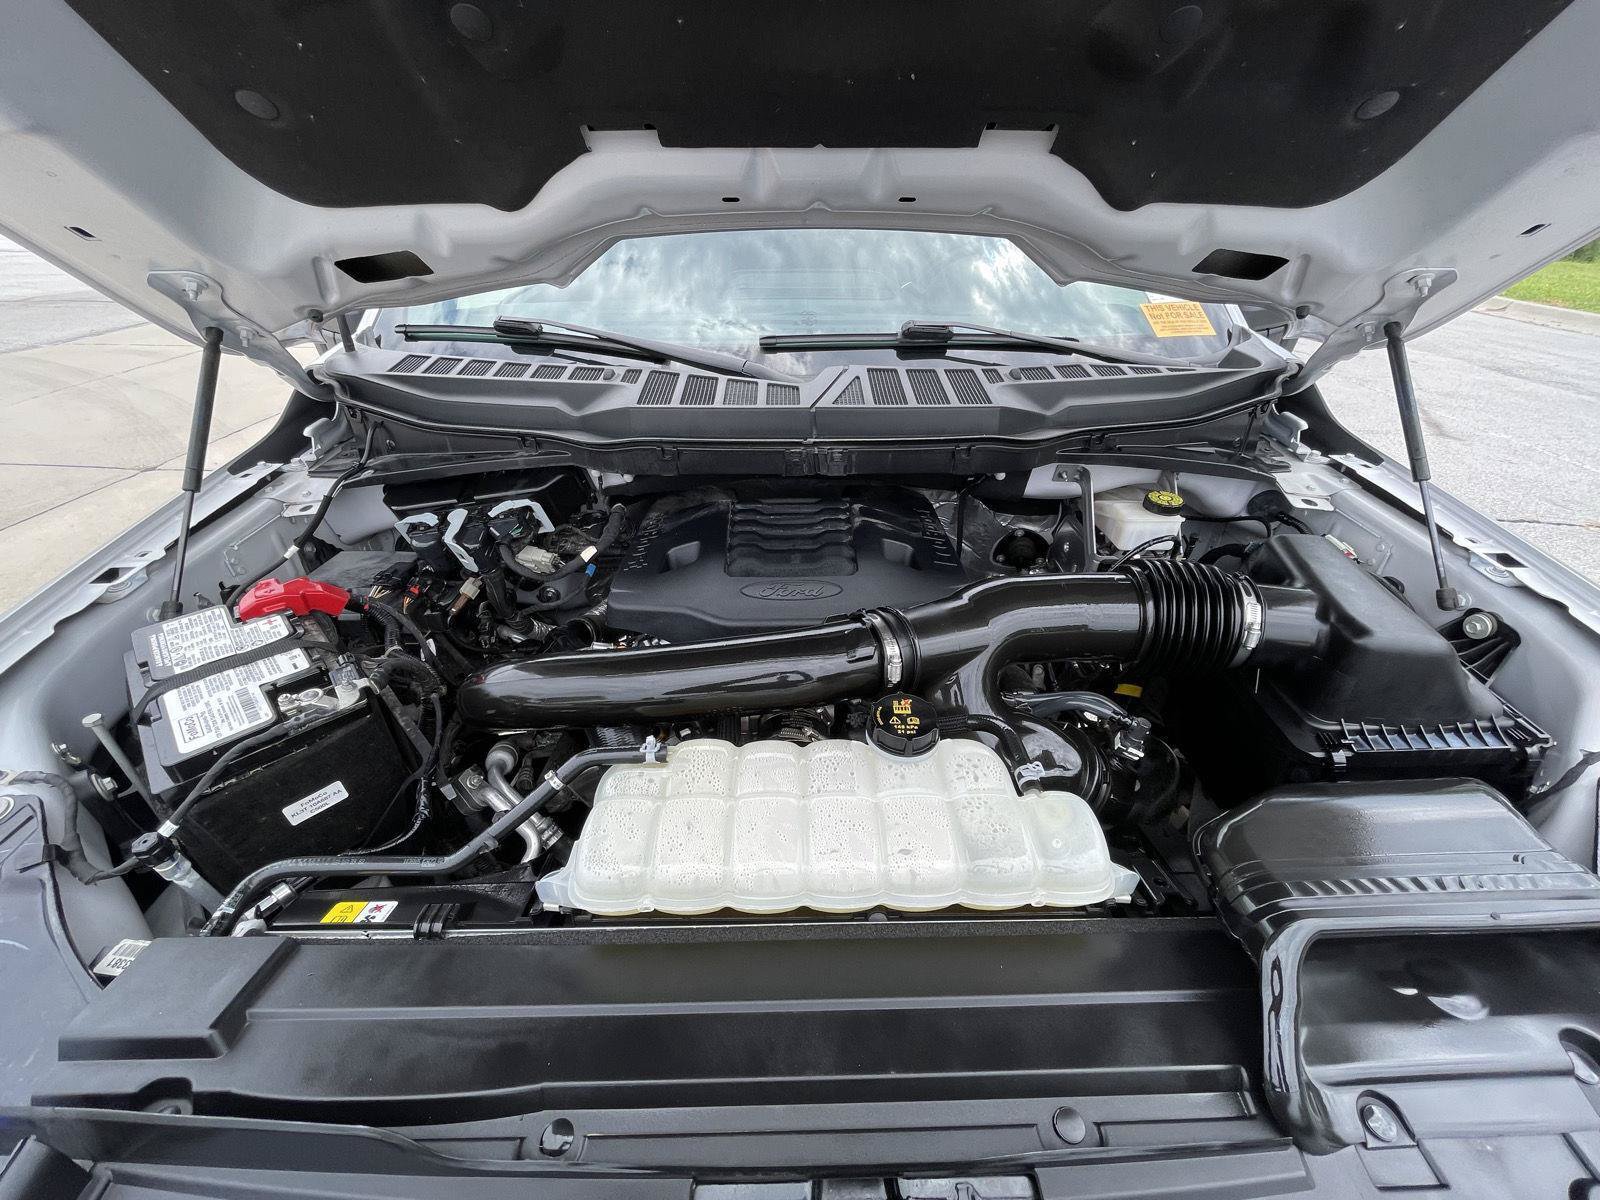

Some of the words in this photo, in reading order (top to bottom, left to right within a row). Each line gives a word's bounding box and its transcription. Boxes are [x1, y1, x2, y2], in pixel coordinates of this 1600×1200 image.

[1144, 304, 1165, 312] THIS
[1166, 303, 1200, 311] VEHICLE
[1166, 312, 1183, 320] FOR
[1183, 311, 1206, 319] SALE
[759, 583, 825, 599] Ford
[300, 791, 328, 807] FoMoCo
